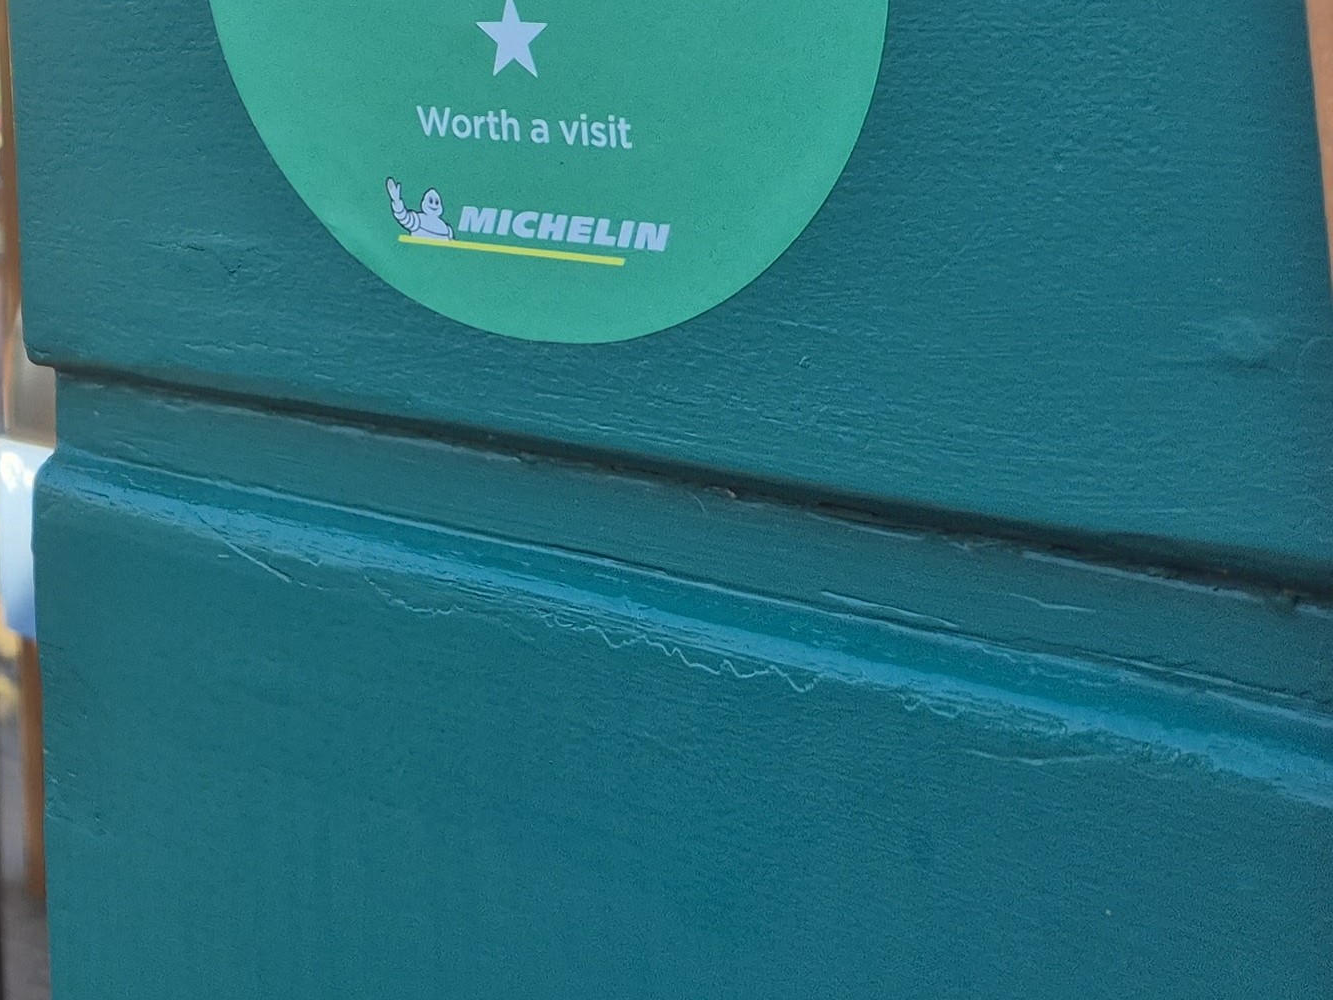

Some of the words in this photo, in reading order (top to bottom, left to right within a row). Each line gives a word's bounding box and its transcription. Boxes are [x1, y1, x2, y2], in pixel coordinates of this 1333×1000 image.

[416, 106, 521, 142] Worth
[530, 119, 550, 144] a
[559, 114, 633, 149] visit
[458, 206, 670, 252] MICHELIN
